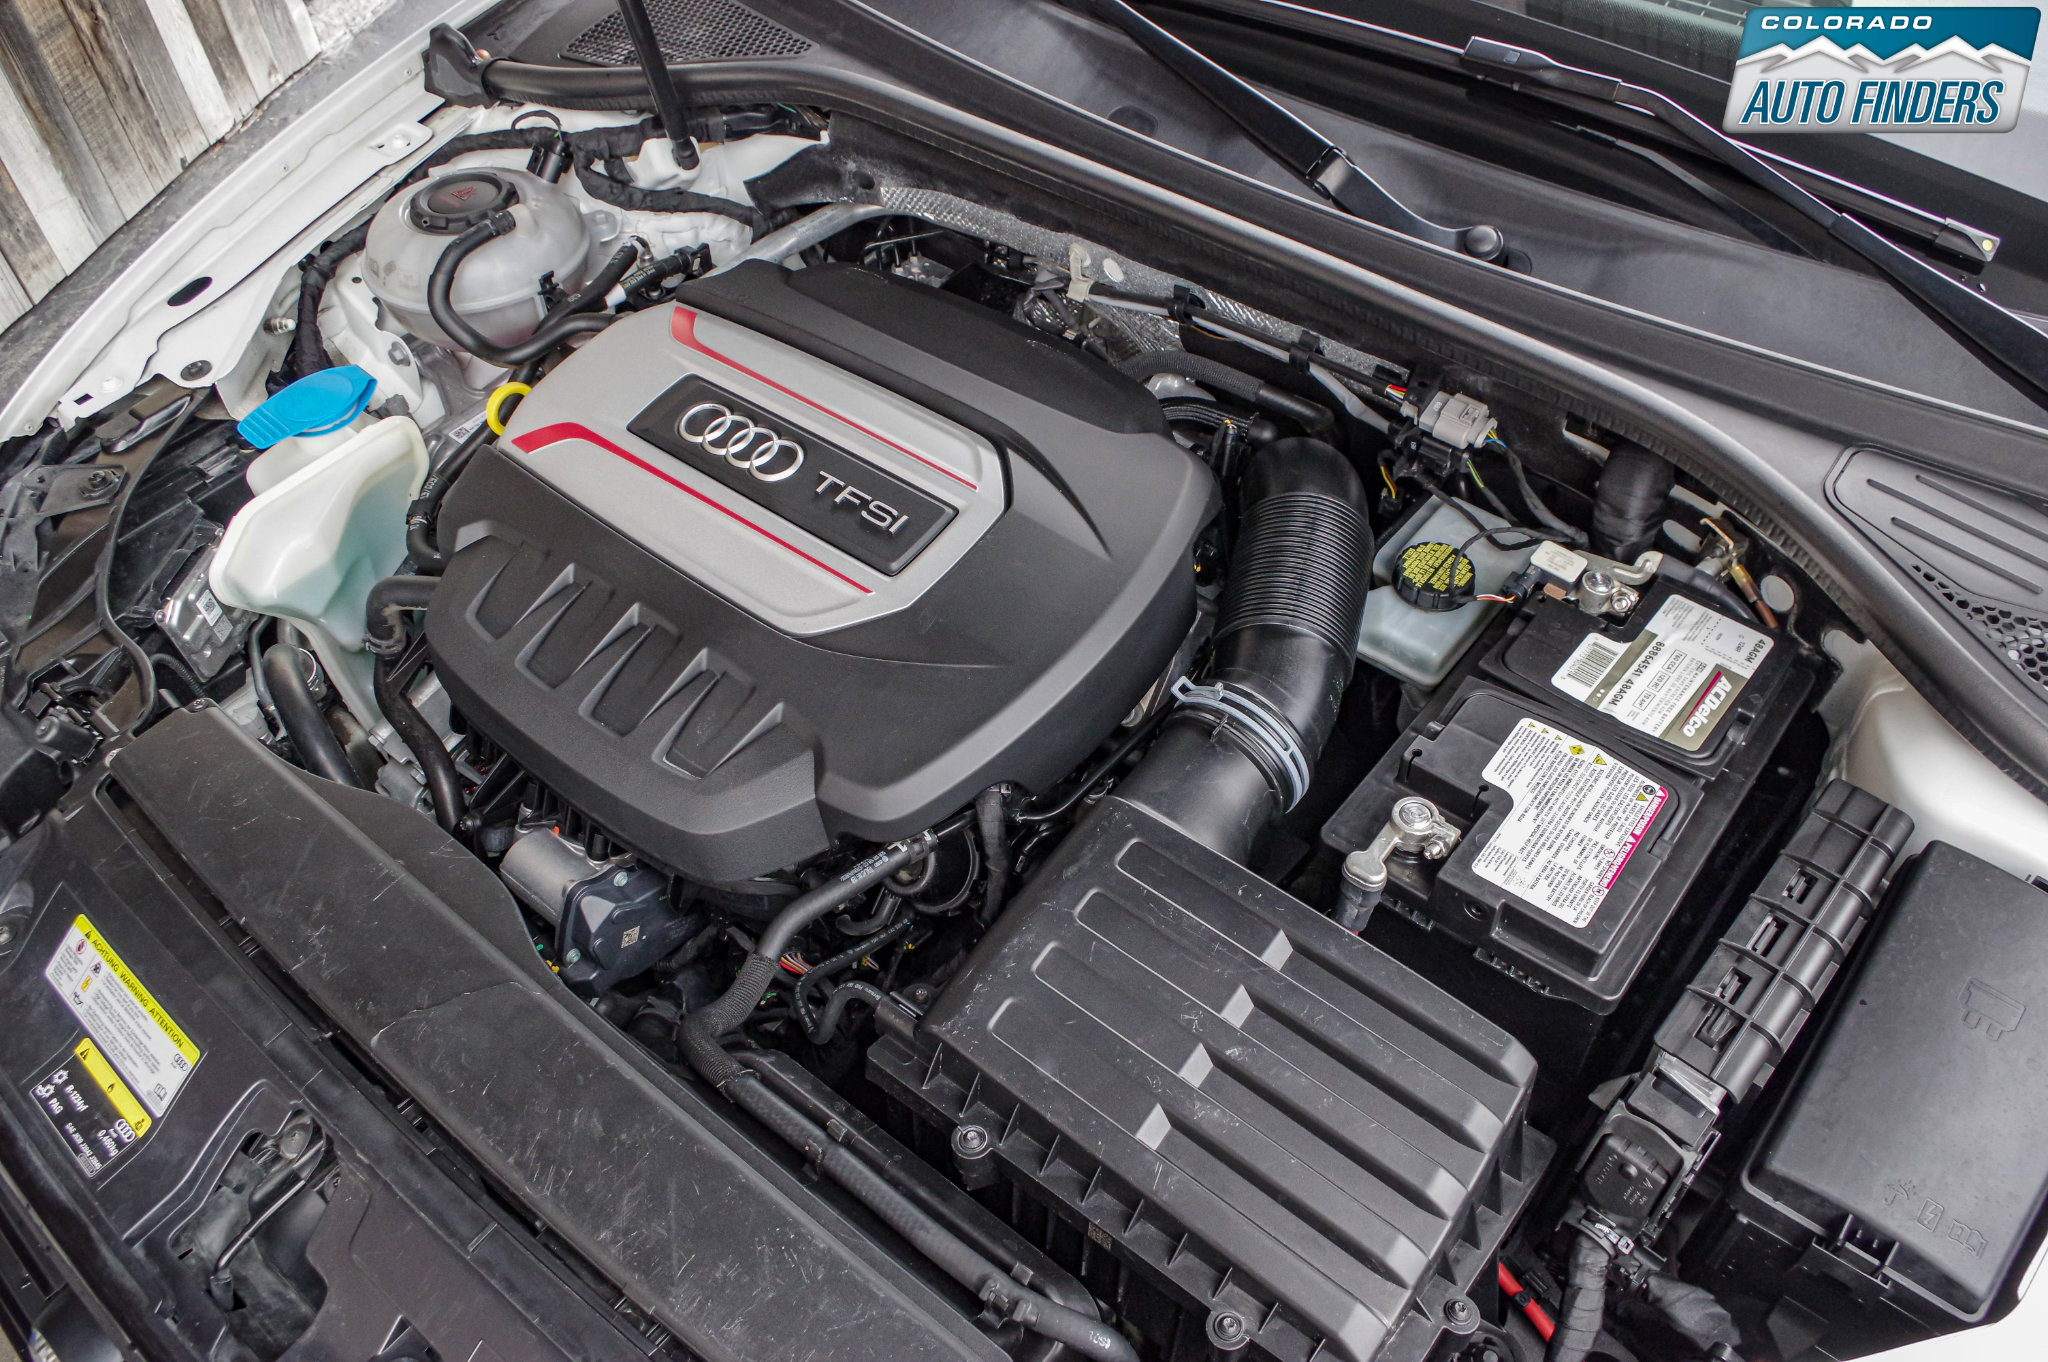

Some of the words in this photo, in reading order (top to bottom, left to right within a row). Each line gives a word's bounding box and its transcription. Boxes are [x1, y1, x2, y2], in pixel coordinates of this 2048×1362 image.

[815, 470, 909, 535] TFSI
[1631, 640, 1665, 677] 88864541
[1743, 638, 1766, 663] 48AGM
[1606, 677, 1635, 707] 48AGM
[1682, 675, 1733, 738] ACDelco
[1631, 796, 1661, 835] DANGER/POISON
[1598, 842, 1632, 887] PELIGRO/VENENO
[91, 937, 119, 972] ACHTUNG
[119, 971, 149, 1007] WARNING
[149, 1005, 184, 1048] ATTENTION
[48, 1097, 63, 1114] PAG
[97, 1128, 119, 1158] 0,460kg
